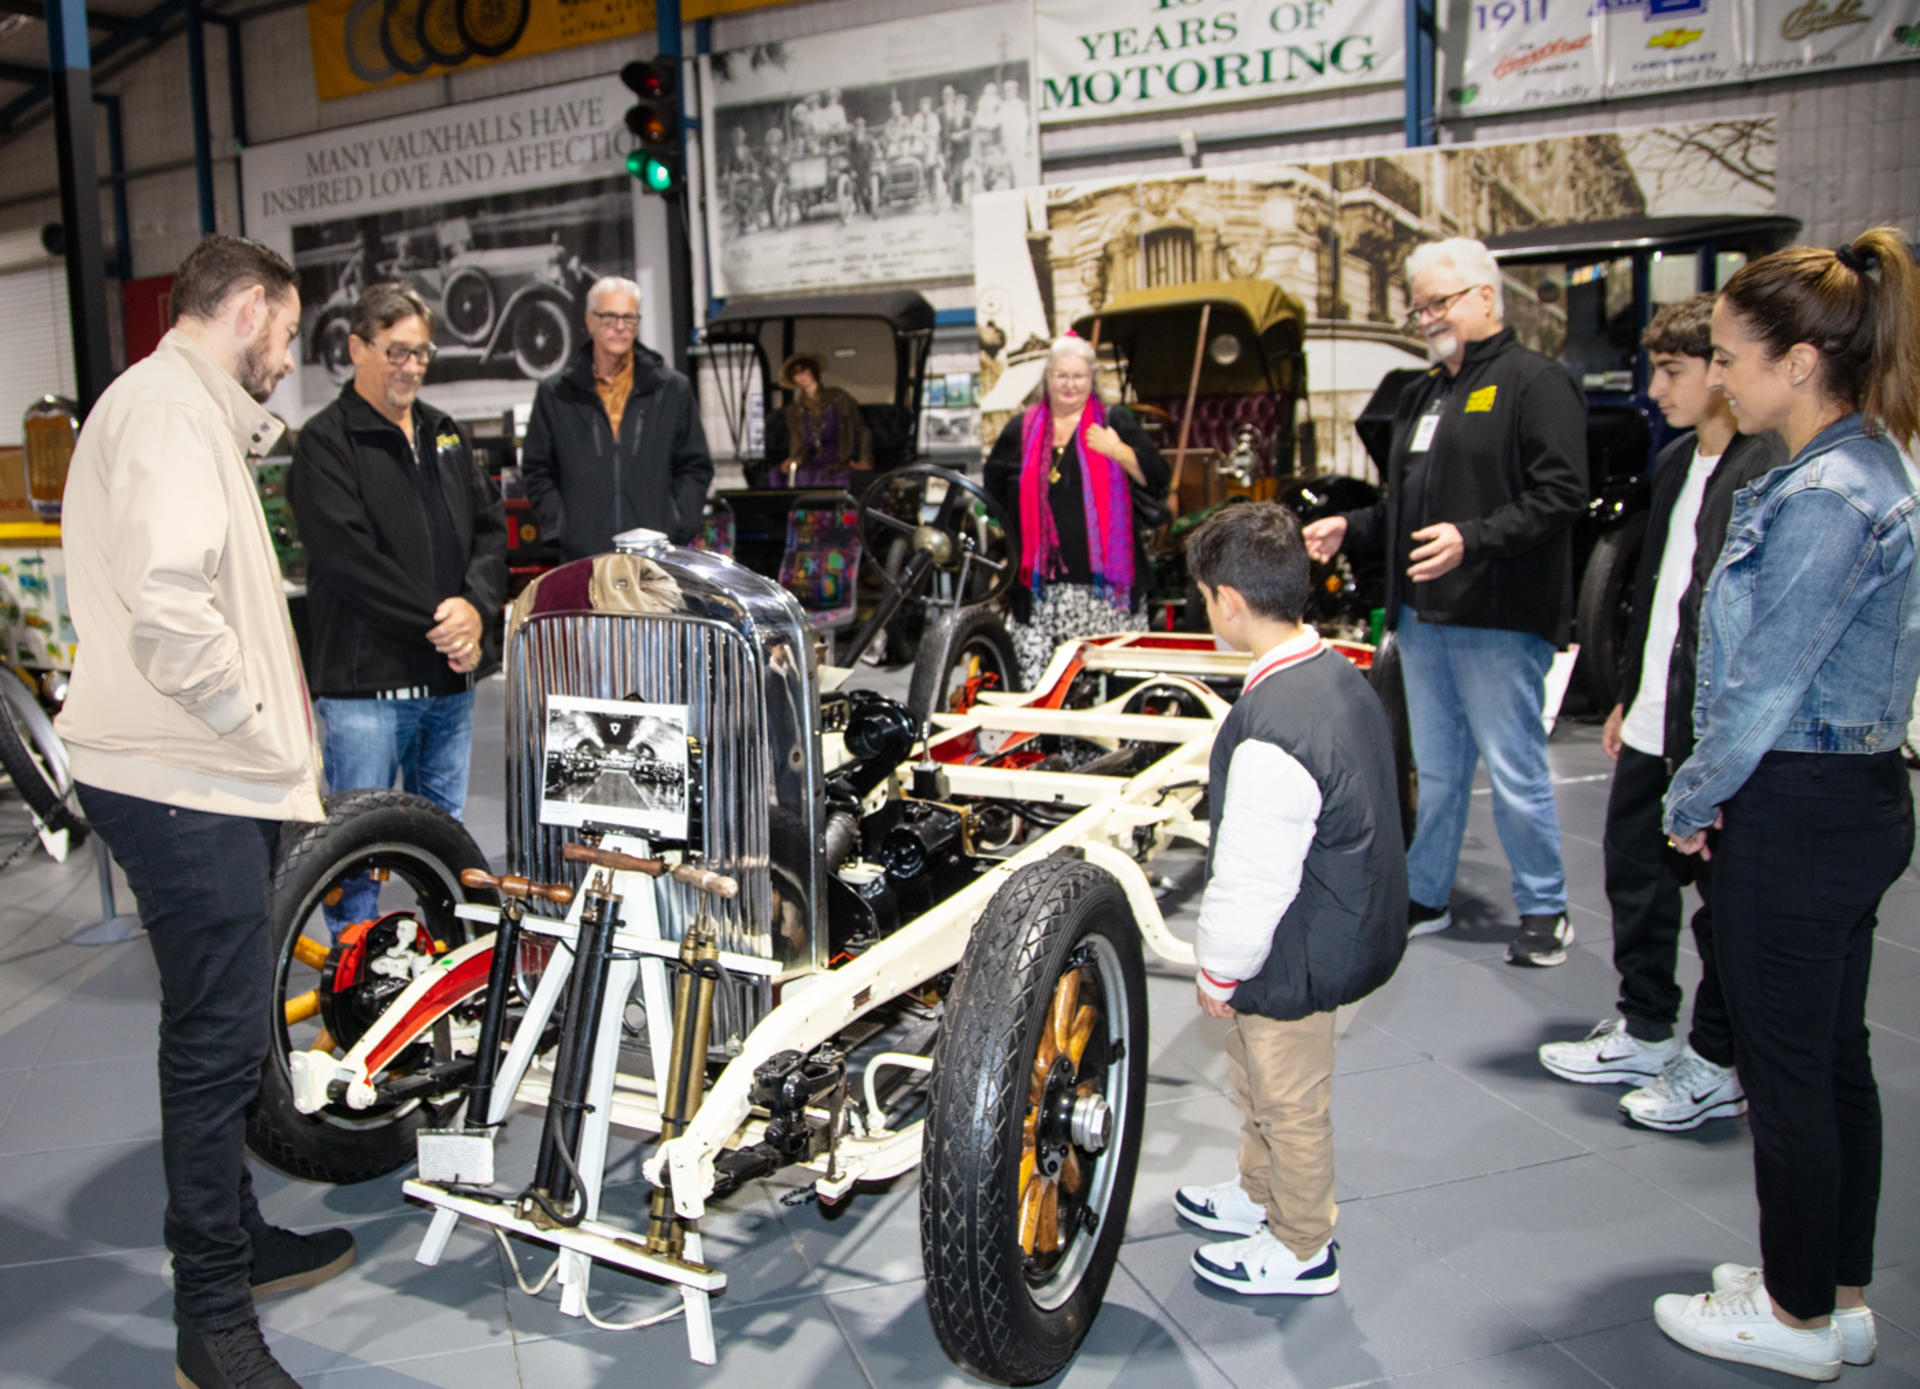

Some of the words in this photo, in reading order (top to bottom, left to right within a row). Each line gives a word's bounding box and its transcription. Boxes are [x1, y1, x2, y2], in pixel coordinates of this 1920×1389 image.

[1079, 11, 1239, 61] YEARS
[1269, 3, 1332, 34] OF
[1042, 36, 1375, 110] MOTORING
[262, 174, 366, 217] INSPIRED
[370, 161, 433, 196] LOVE
[439, 150, 496, 187] AND
[502, 128, 638, 176] AFFECTIO
[306, 140, 375, 178] MANY
[380, 111, 524, 163] VAUXHALLS
[531, 96, 606, 137] HAVE
